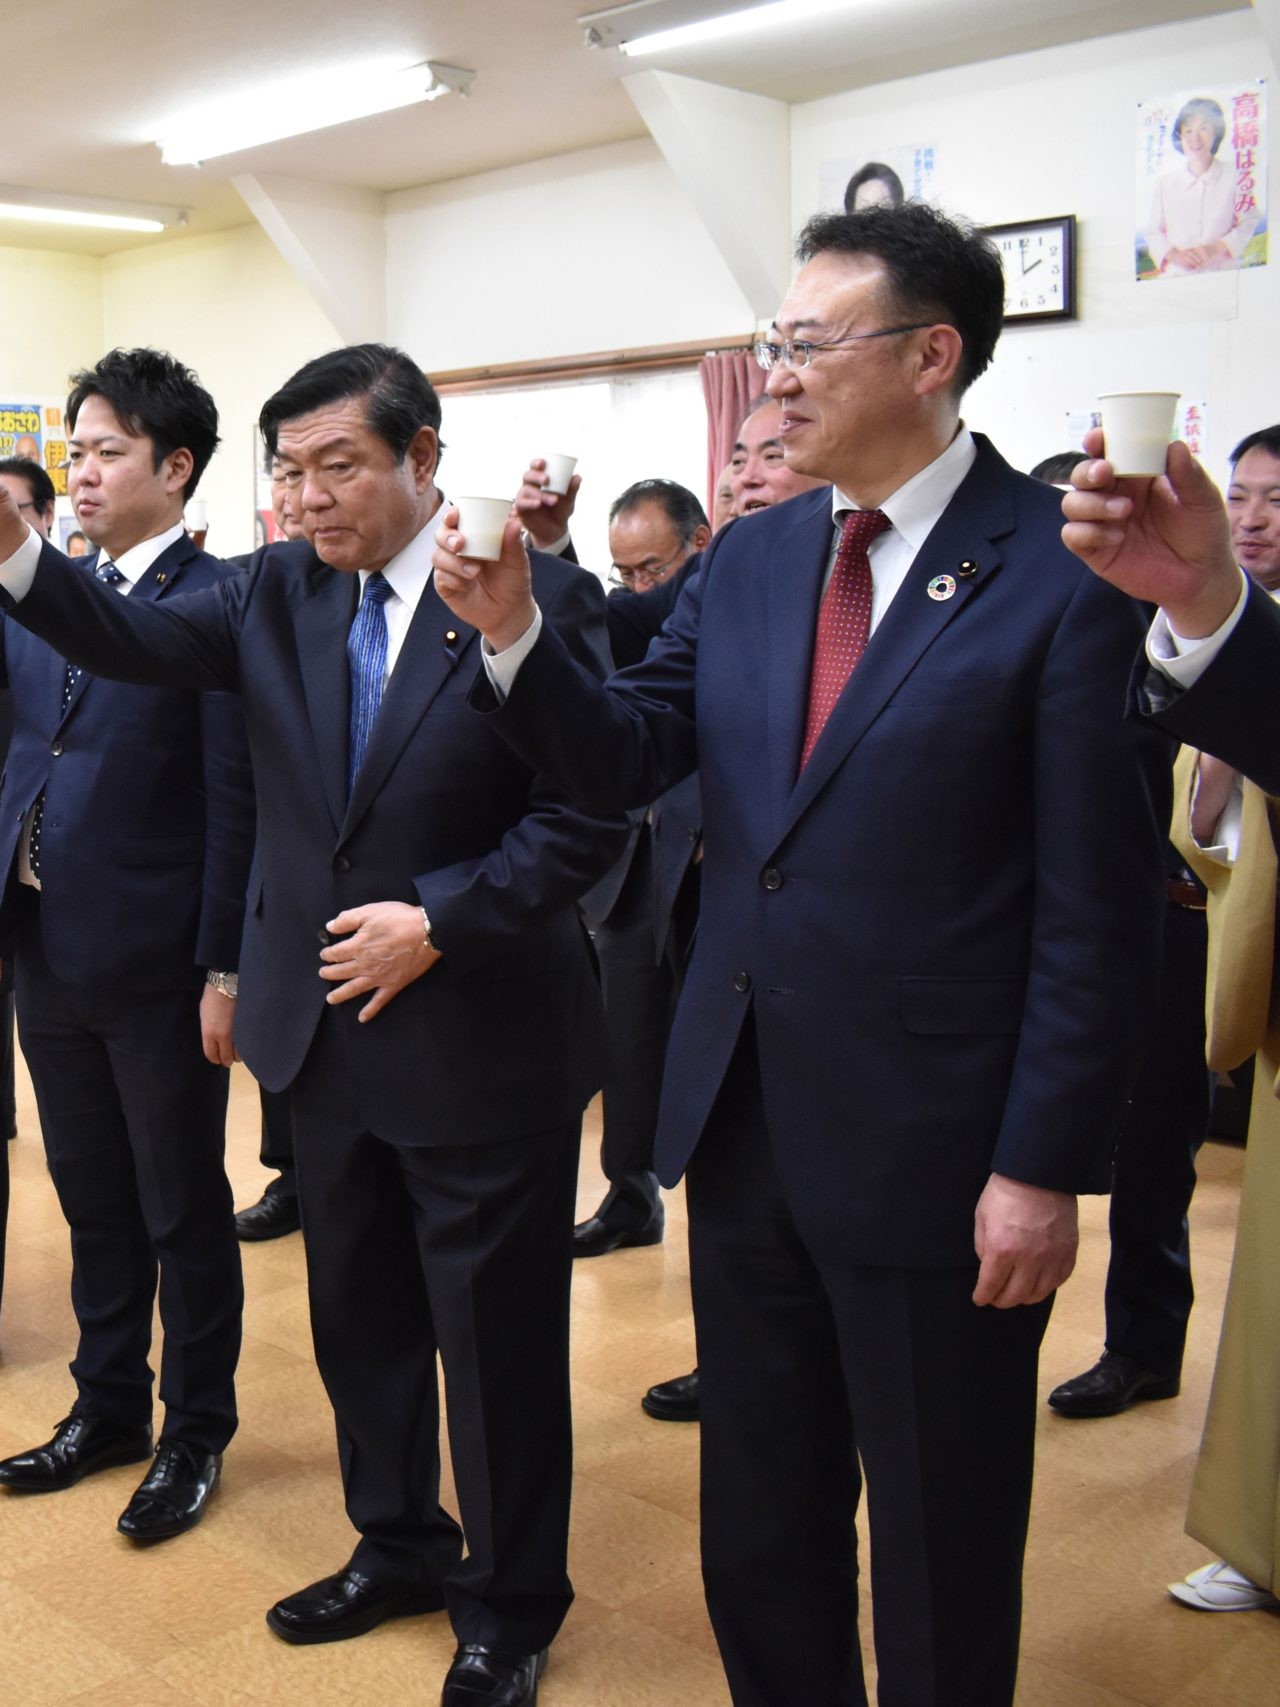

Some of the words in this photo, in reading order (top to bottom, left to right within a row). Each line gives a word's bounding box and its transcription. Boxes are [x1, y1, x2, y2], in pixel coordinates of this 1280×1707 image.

[1231, 93, 1260, 213] 高橋はるみ
[1003, 241, 1012, 250] 11
[1050, 246, 1058, 256] 2
[1052, 265, 1060, 274] 3
[1050, 284, 1058, 293] 4
[1020, 298, 1029, 308] 6
[1038, 295, 1046, 305] 5
